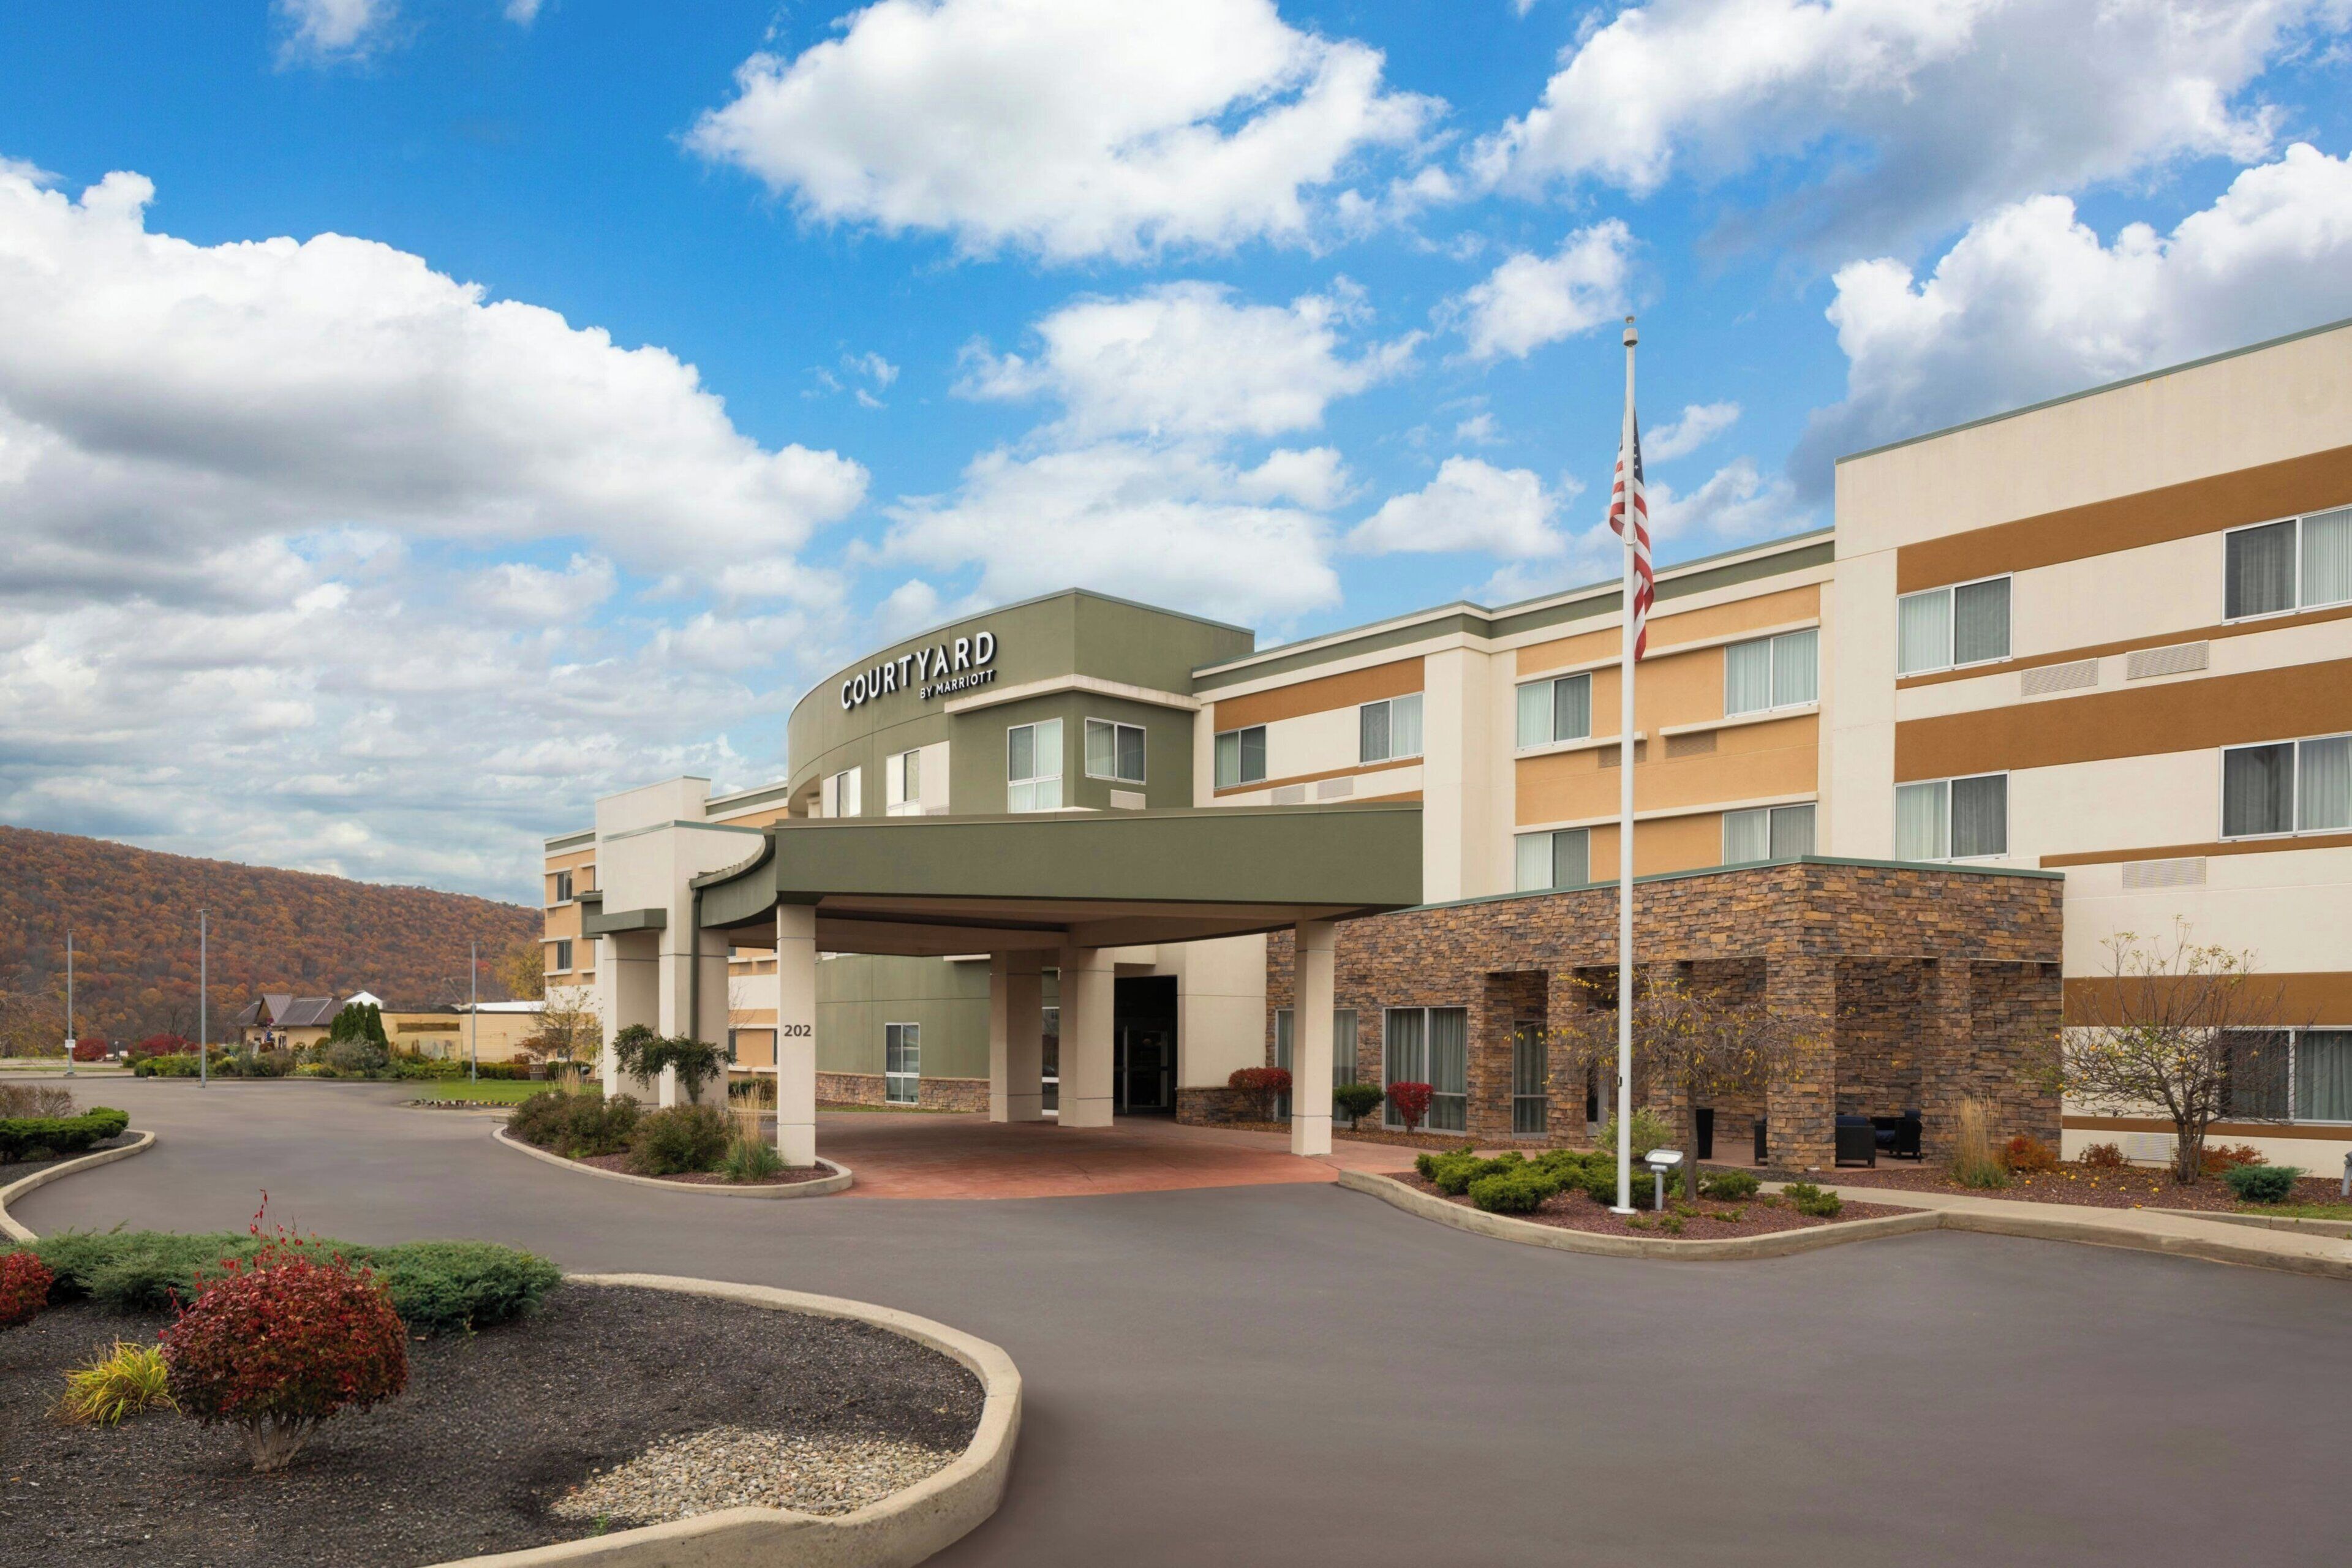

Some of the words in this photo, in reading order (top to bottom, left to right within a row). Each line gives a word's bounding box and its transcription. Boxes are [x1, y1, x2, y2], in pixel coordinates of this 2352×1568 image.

[841, 631, 995, 709] COURTYARD
[920, 685, 933, 699] BY
[936, 669, 995, 695] MARRIOTT
[784, 1024, 812, 1037] 202
